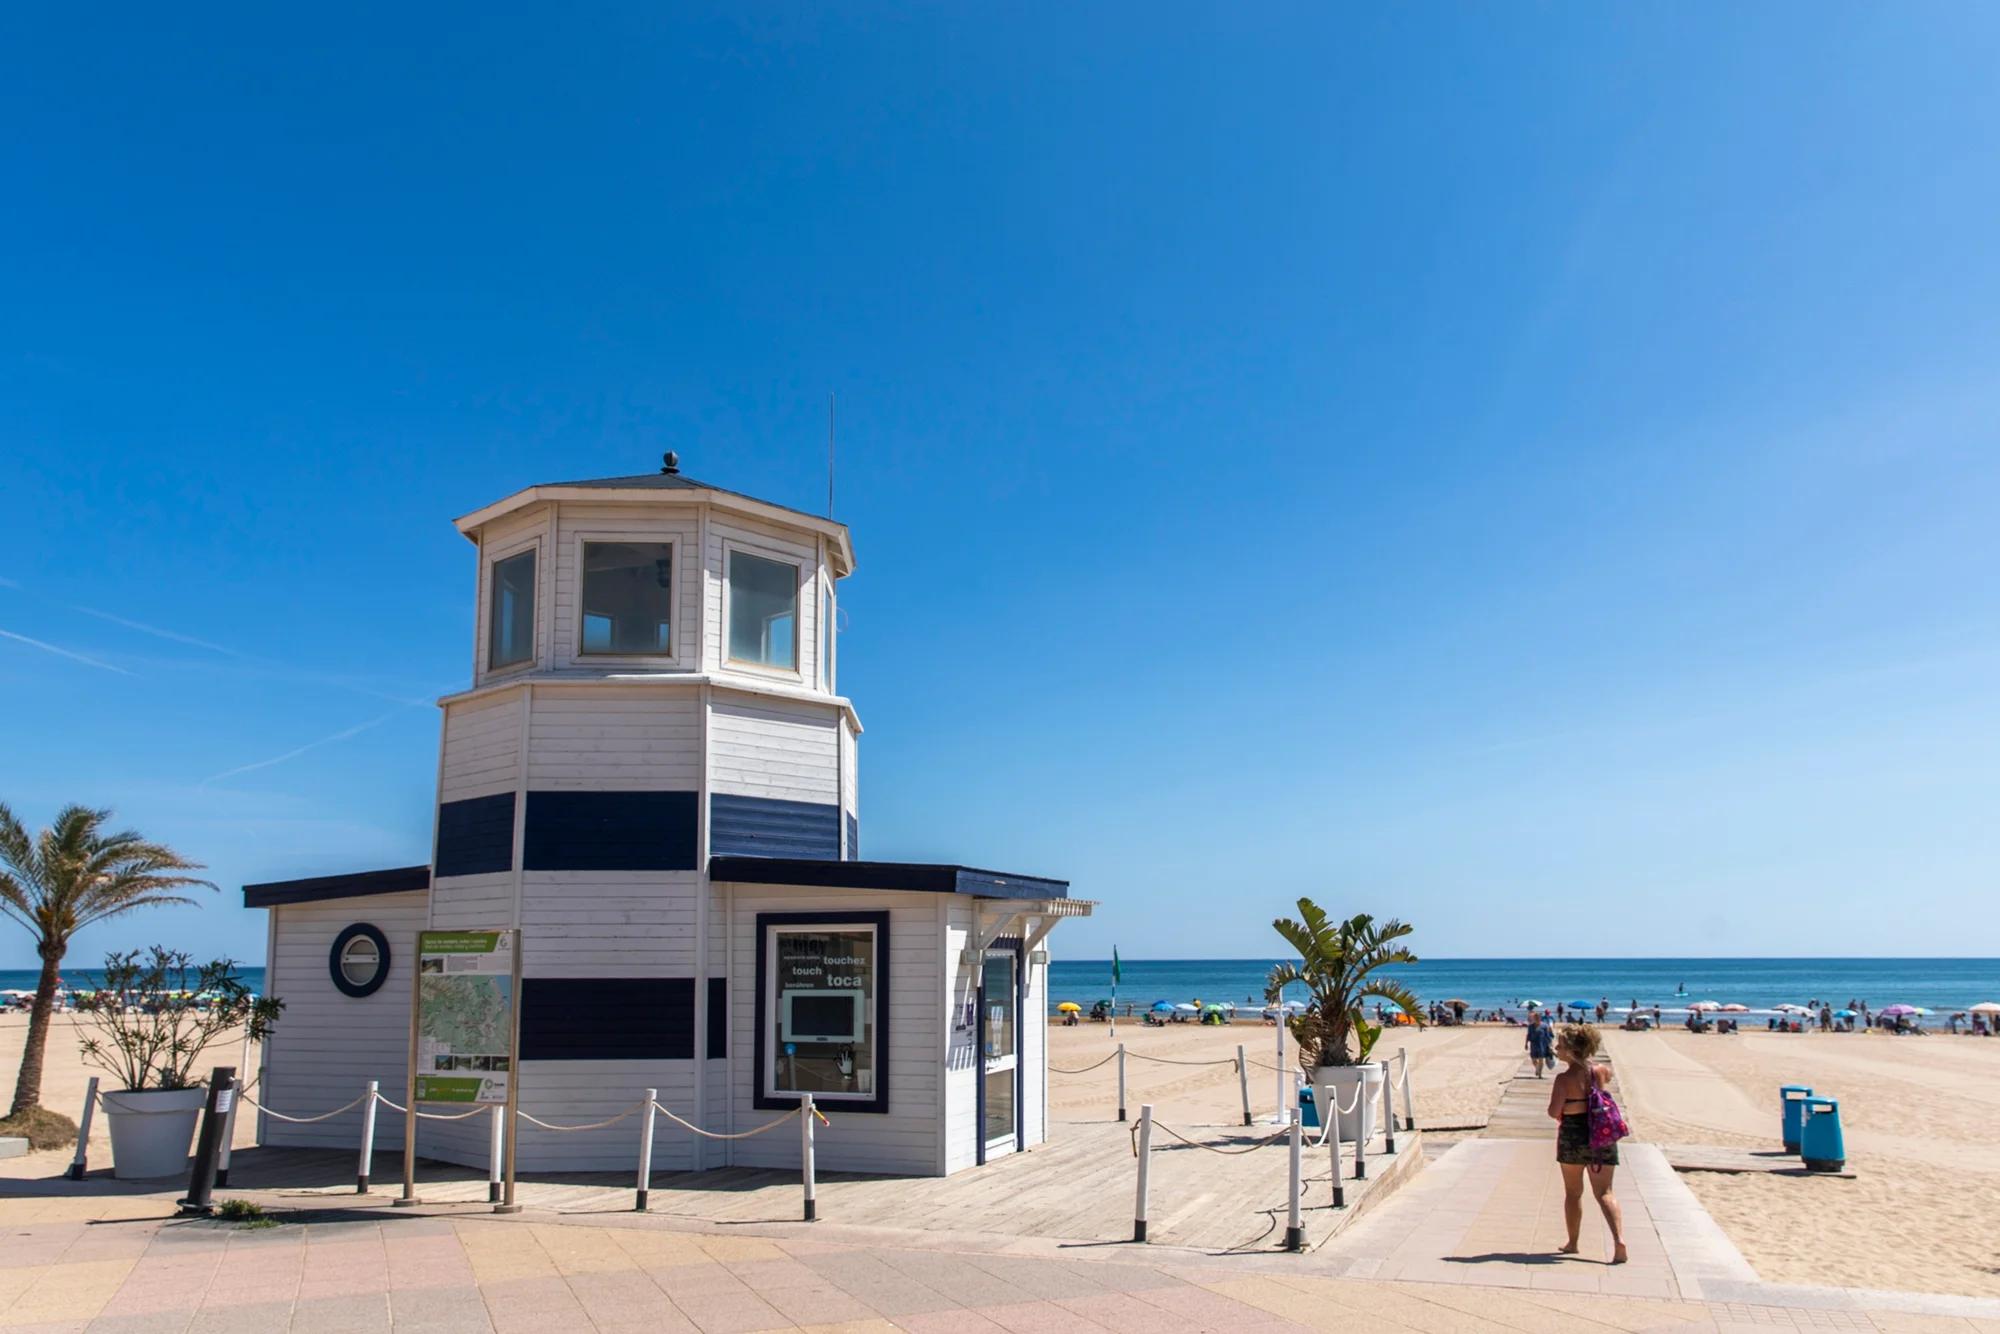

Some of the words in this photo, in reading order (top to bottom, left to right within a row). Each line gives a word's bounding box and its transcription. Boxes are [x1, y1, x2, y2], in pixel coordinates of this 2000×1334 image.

[823, 955, 865, 965] touchez
[792, 966, 822, 975] touch
[827, 974, 862, 986] toca
